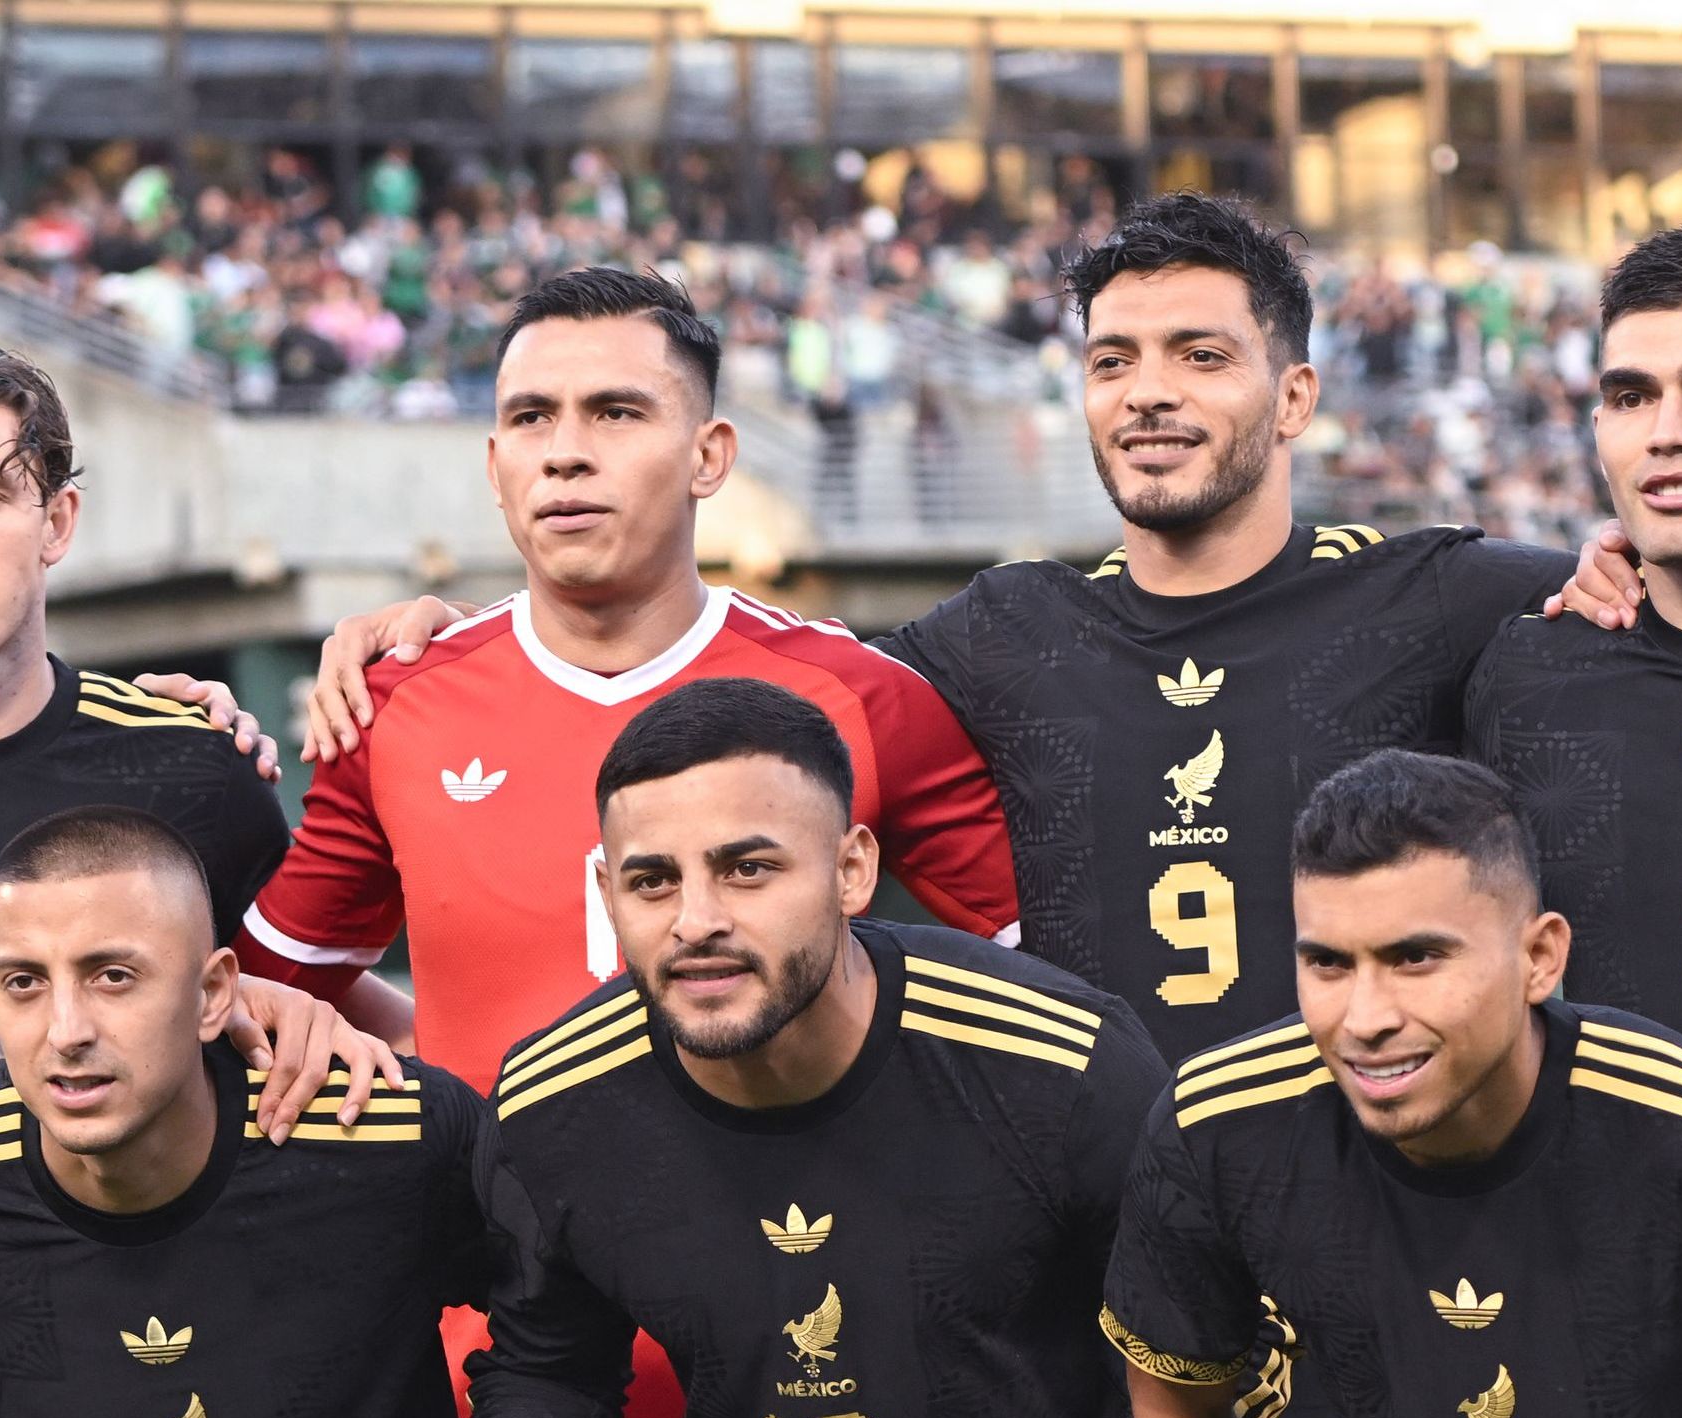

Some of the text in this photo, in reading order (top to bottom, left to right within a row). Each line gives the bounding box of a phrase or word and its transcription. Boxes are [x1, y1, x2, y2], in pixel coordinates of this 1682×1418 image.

[1149, 824, 1229, 848] MÉXICO
[1148, 860, 1240, 1006] 9
[776, 1375, 858, 1398] MÉXICO
